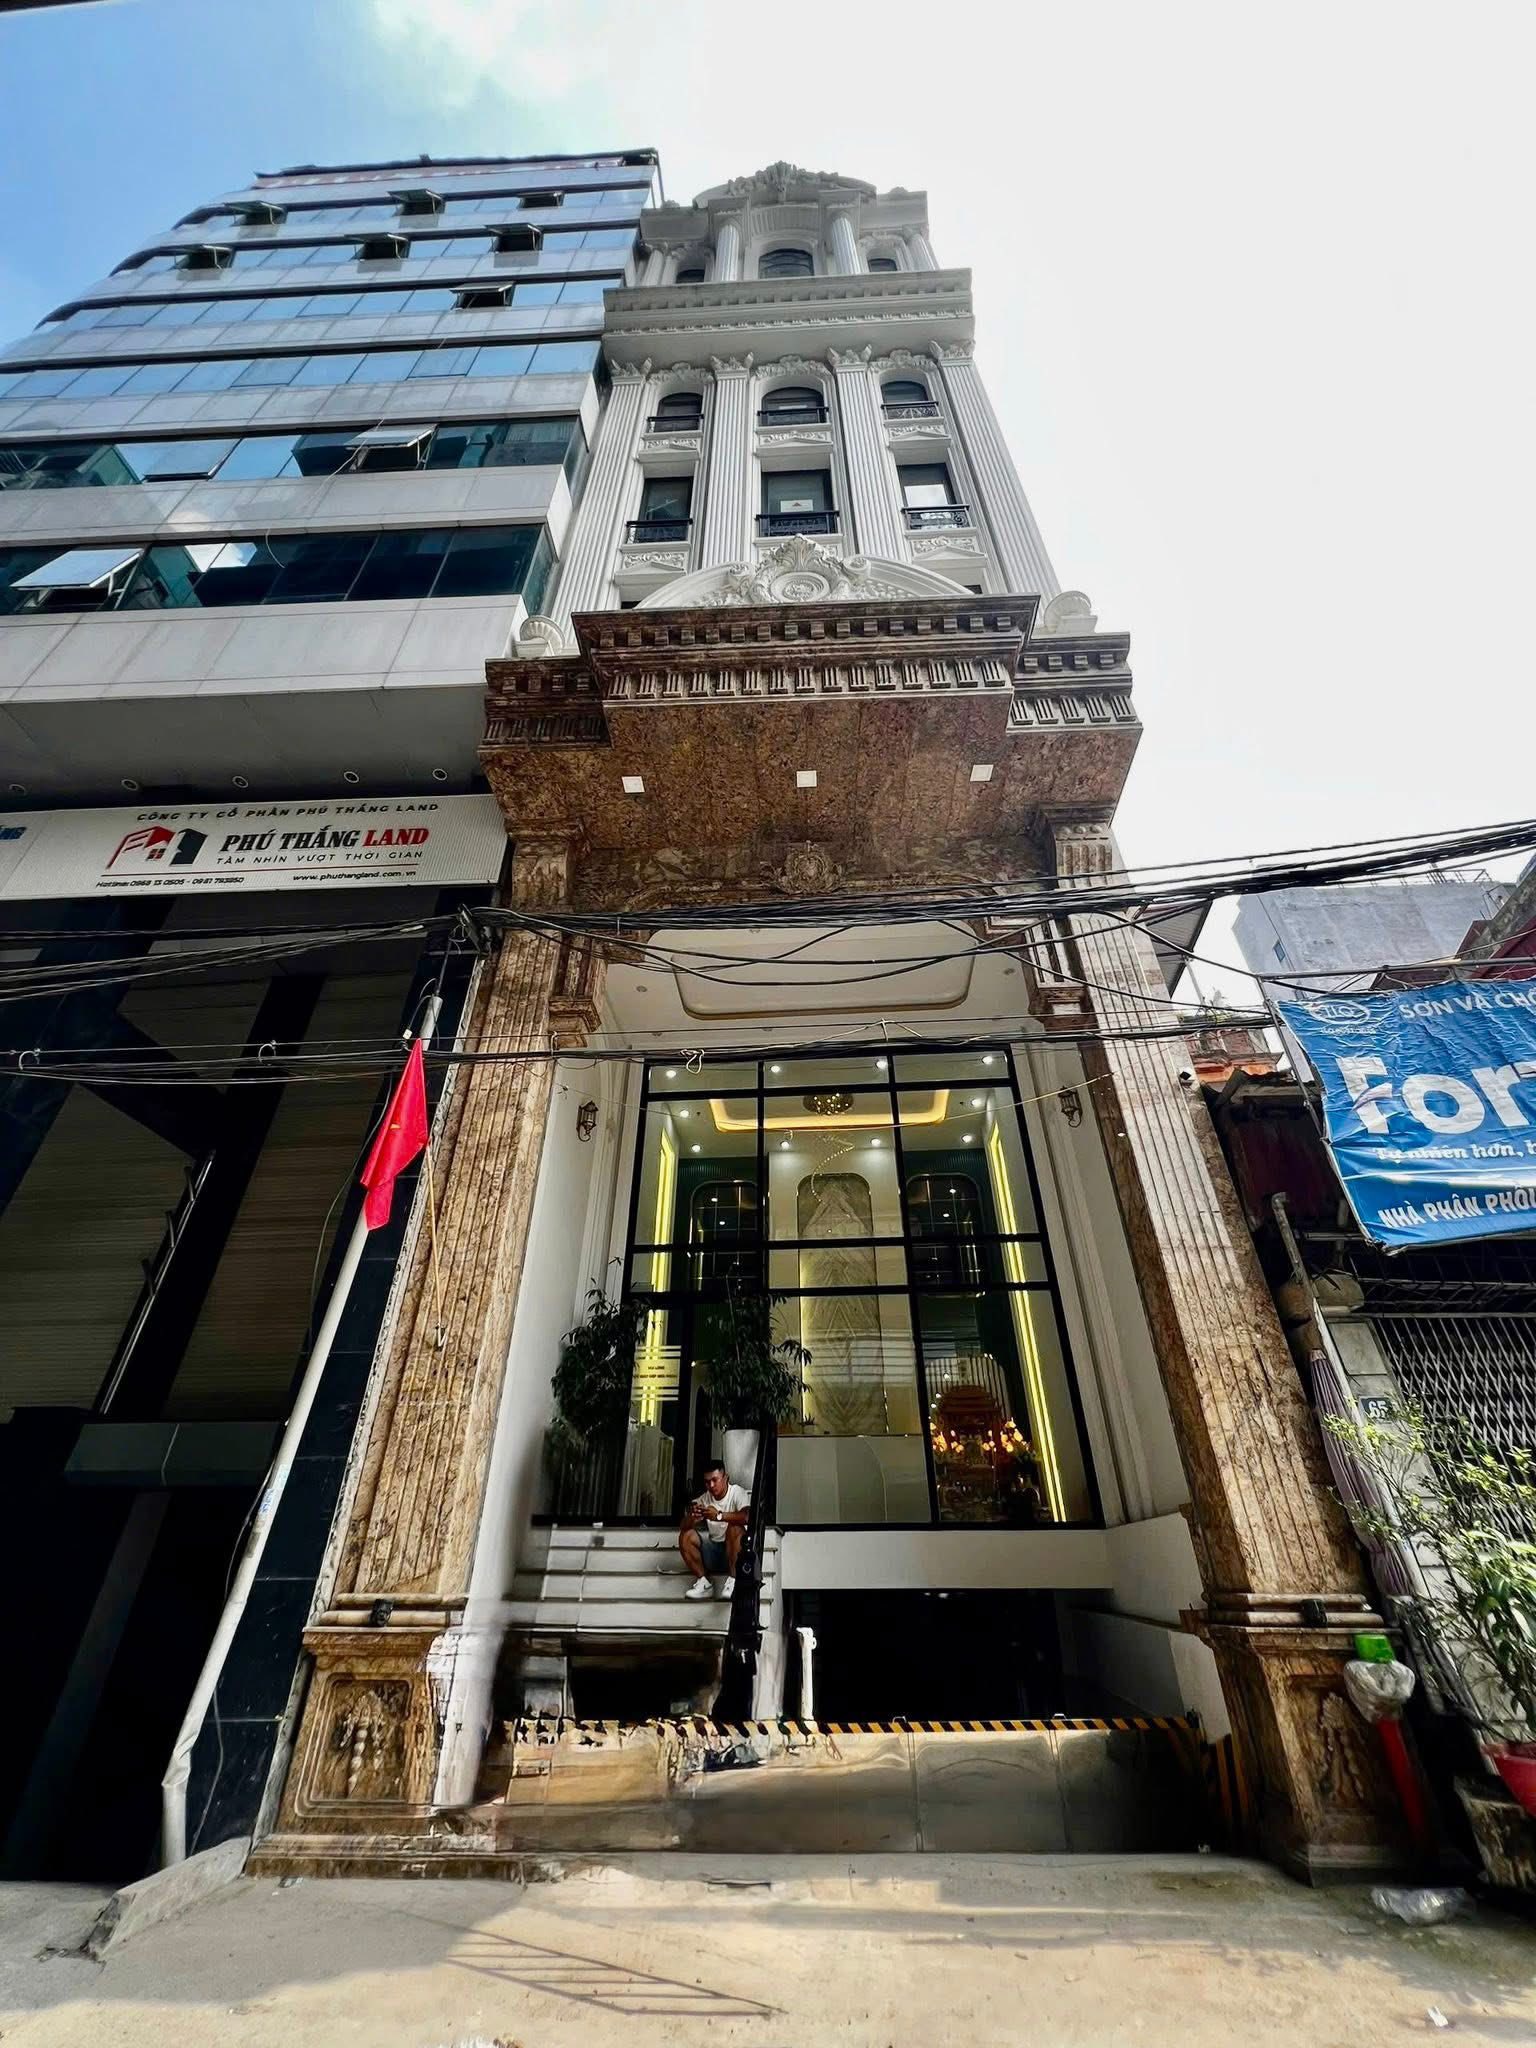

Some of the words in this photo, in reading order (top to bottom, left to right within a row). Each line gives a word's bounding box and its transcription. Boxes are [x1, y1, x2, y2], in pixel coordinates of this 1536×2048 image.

[137, 812, 181, 821] CÔNG
[296, 807, 328, 815] PHÚ
[395, 803, 438, 812] LAND
[220, 828, 276, 852] PHÚ
[280, 824, 361, 850] THẮNG
[363, 827, 430, 847] LAND
[388, 851, 423, 859] GIAN
[1400, 999, 1455, 1019] SƠN
[1377, 1200, 1427, 1228] NHÀ
[1423, 1193, 1485, 1222] PHÂN
